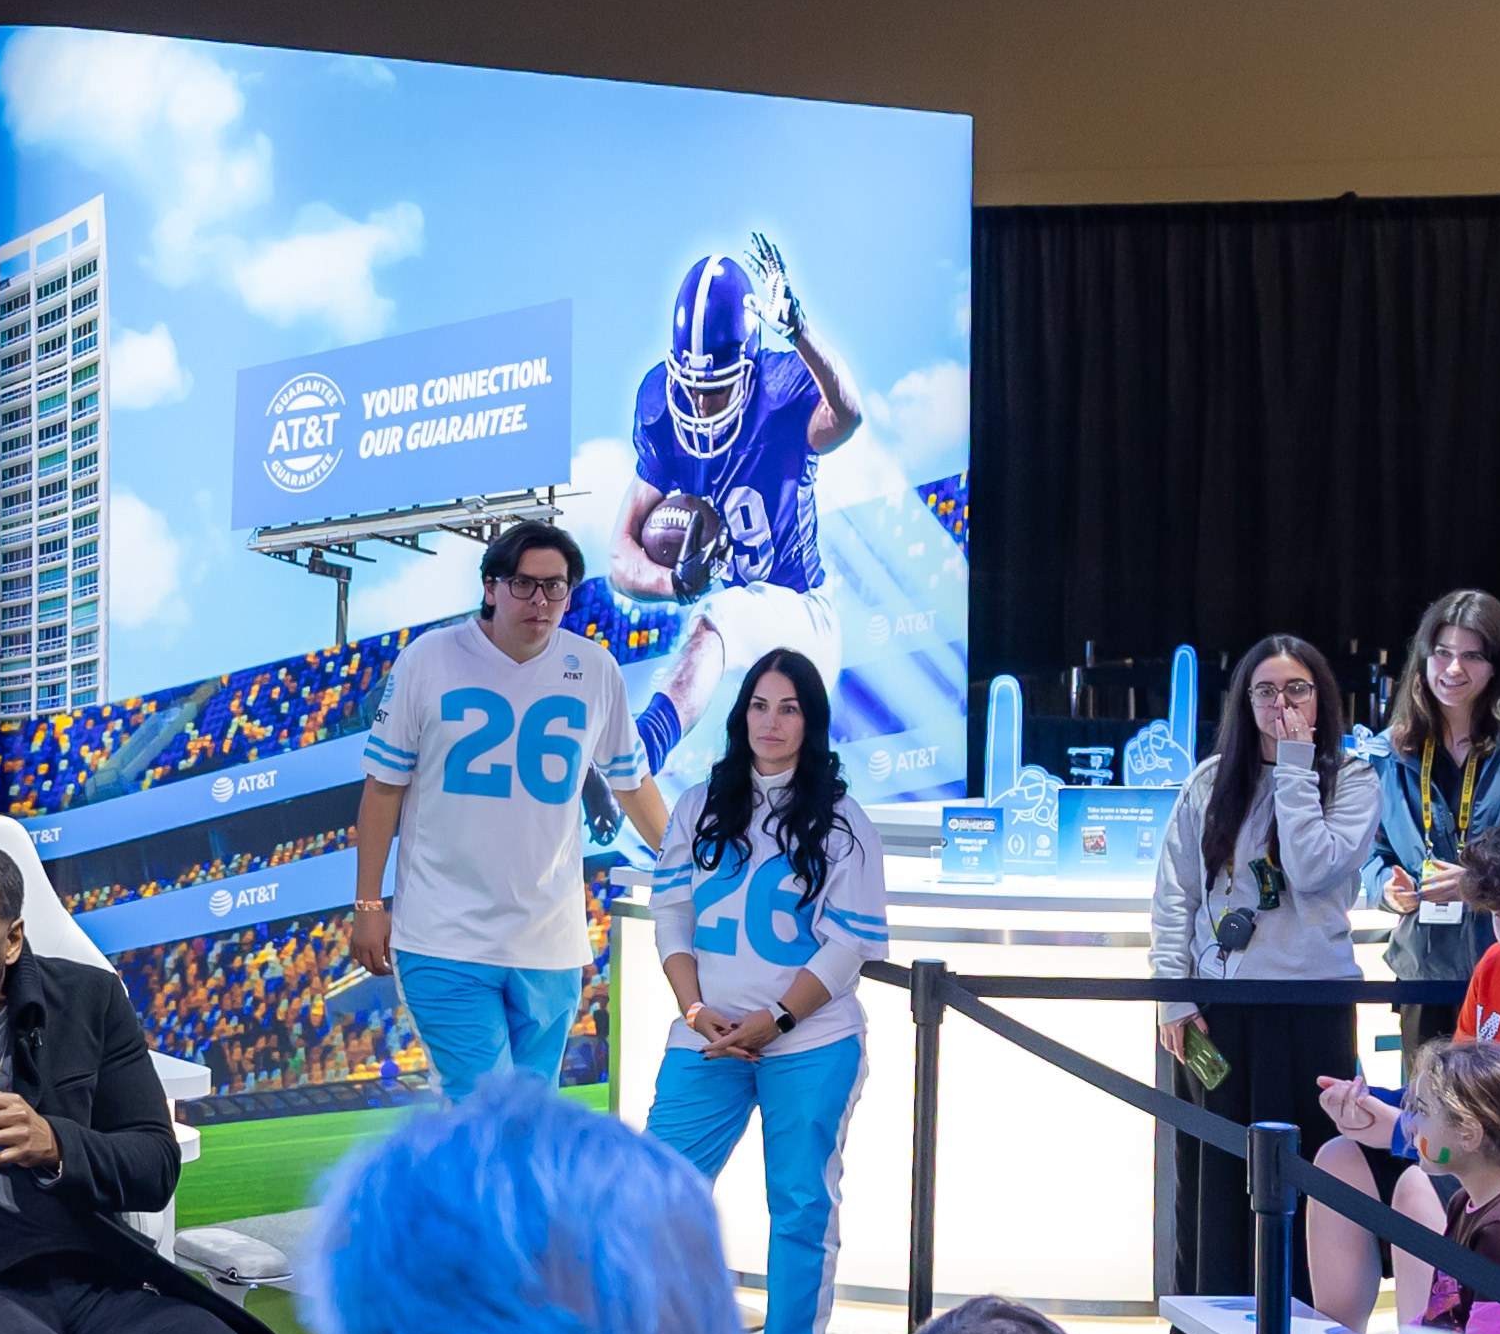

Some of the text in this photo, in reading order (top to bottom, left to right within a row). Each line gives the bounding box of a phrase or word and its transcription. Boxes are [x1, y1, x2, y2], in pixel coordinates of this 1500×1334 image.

[274, 379, 339, 415] GUARANTEE
[361, 356, 553, 420] YOUR CONNECTION.
[267, 412, 341, 455] AT&T
[358, 403, 529, 460] OUR GUARANTEE.
[271, 451, 335, 487] GUARANTEE
[722, 485, 775, 581] 9
[895, 609, 937, 637] AT&T
[562, 671, 584, 681] AT&T
[441, 687, 587, 805] 26
[896, 745, 940, 772] AT&T
[237, 770, 278, 794] AT&T
[30, 827, 63, 845] T&T
[236, 882, 280, 909] AT&T
[693, 835, 823, 967] 26
